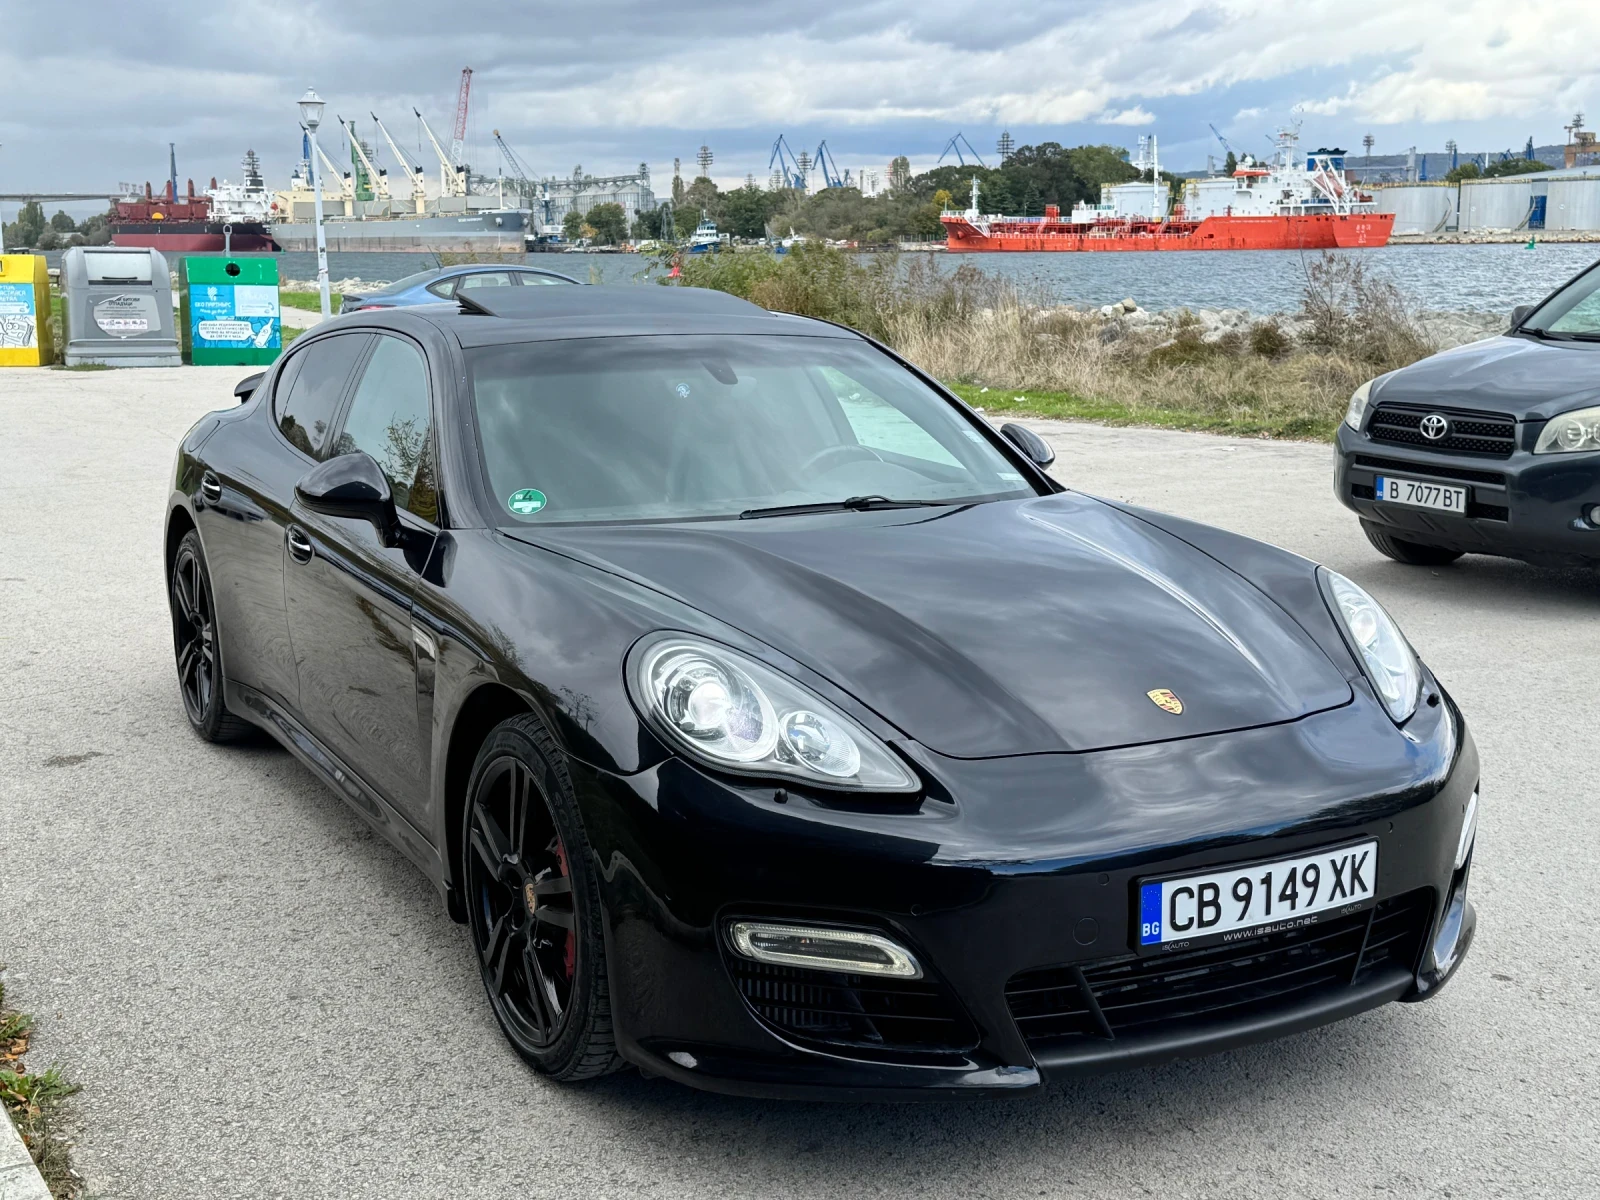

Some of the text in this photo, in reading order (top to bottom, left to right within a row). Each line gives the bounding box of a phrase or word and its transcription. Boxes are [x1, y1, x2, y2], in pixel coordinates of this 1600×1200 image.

[522, 490, 533, 501] 4
[1390, 481, 1463, 509] B 7077 BT
[1170, 850, 1370, 932] CB 9149 XK
[1142, 921, 1160, 937] BG
[1223, 915, 1318, 941] www.isauto.net
